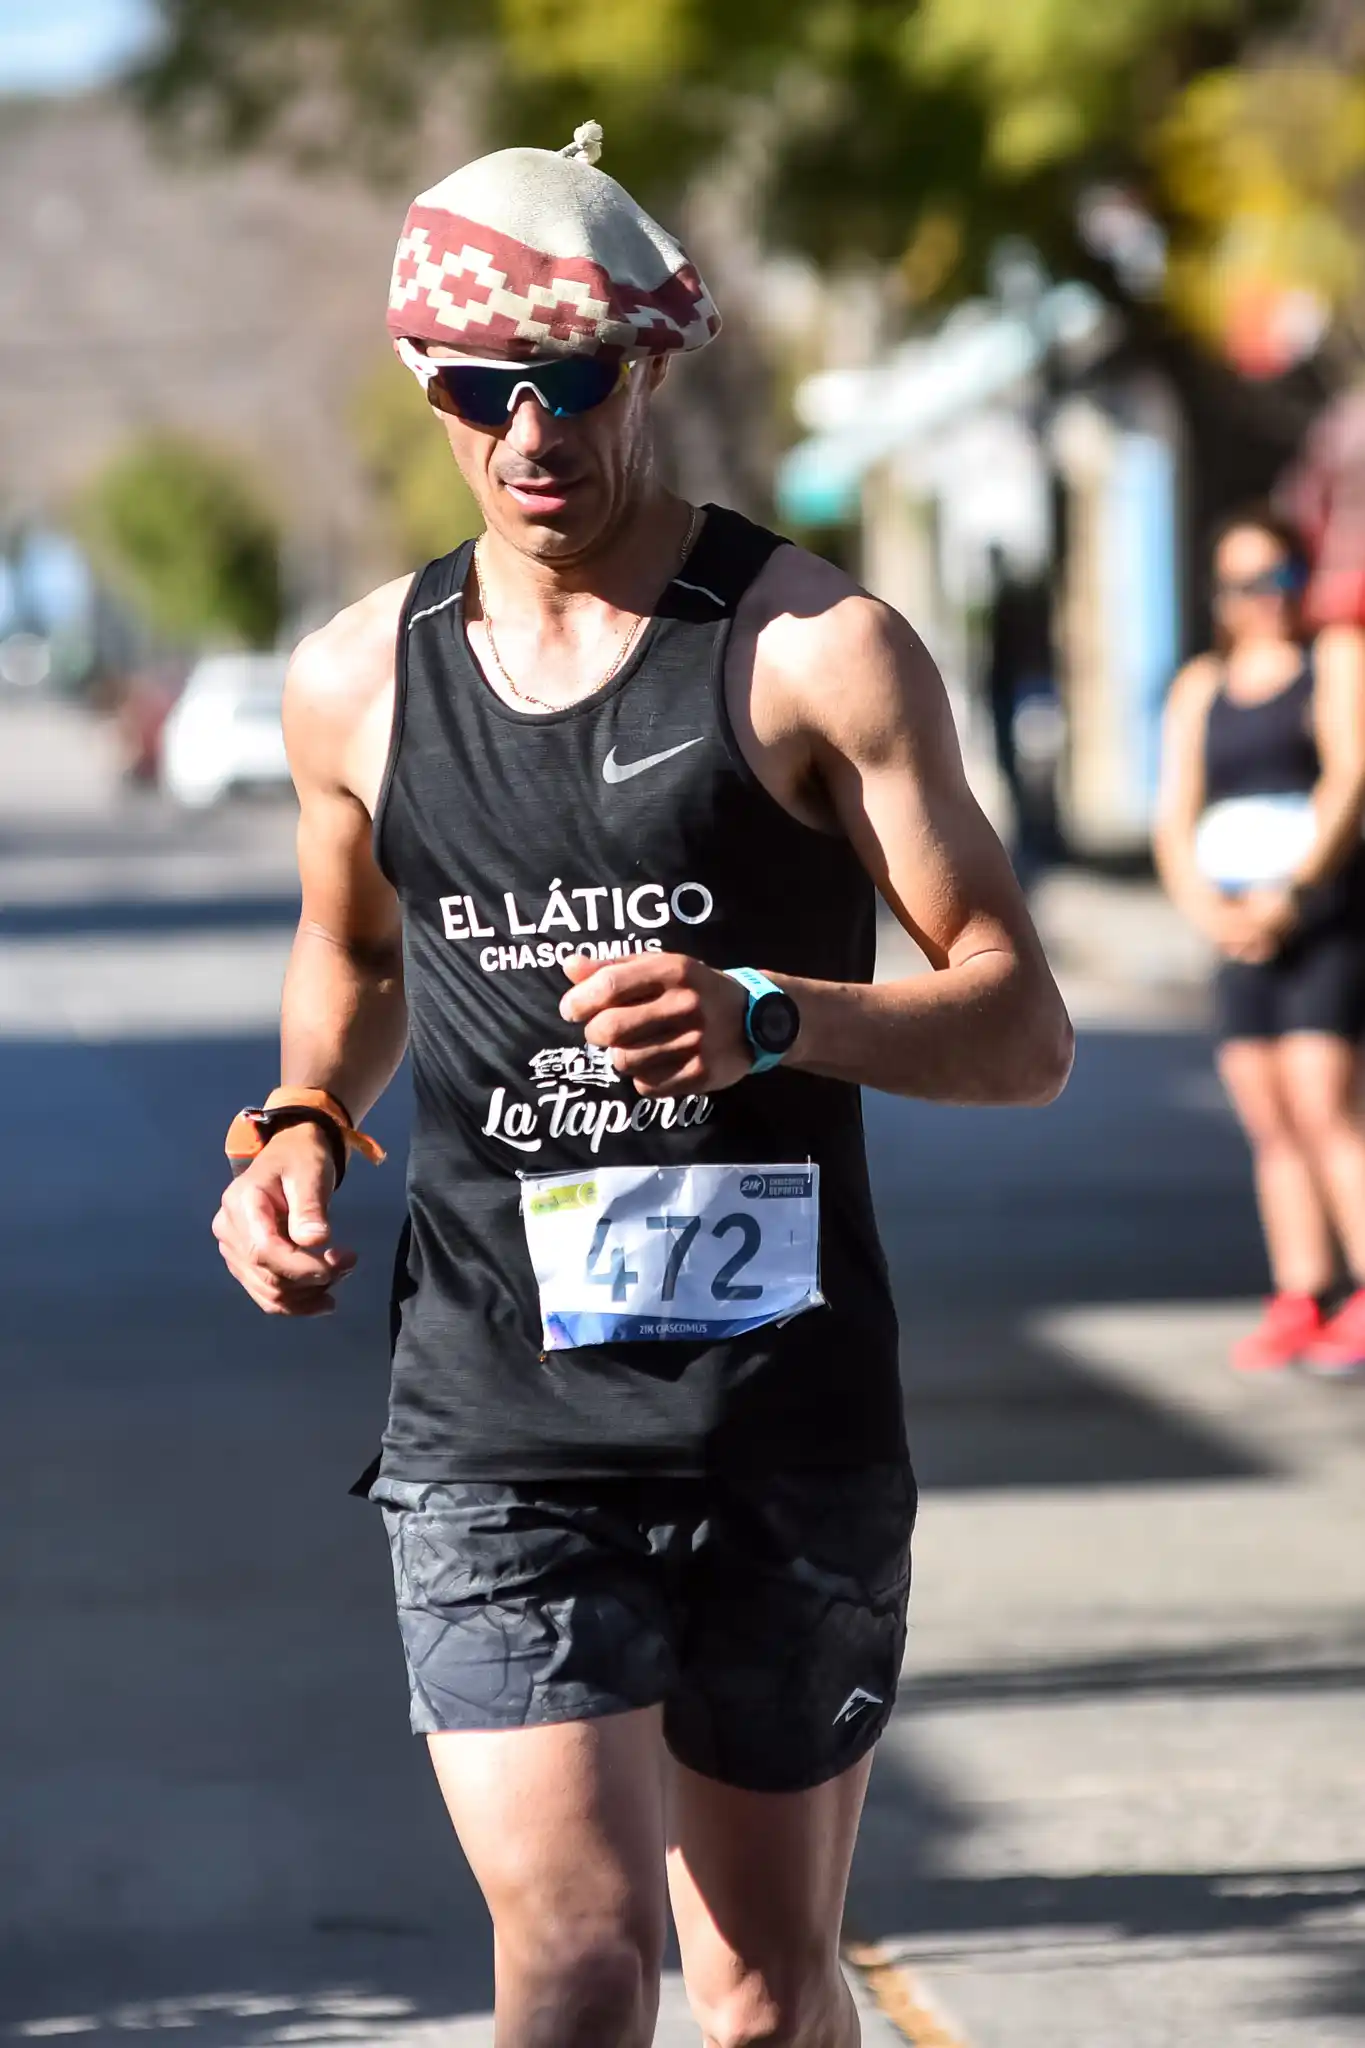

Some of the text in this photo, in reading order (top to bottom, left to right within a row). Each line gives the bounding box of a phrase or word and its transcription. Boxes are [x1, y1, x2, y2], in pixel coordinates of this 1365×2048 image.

[439, 877, 713, 940] EL LÁTIGO
[479, 933, 662, 972] CHASCOMÚS
[481, 1086, 541, 1152] La
[586, 1213, 763, 1302] 472
